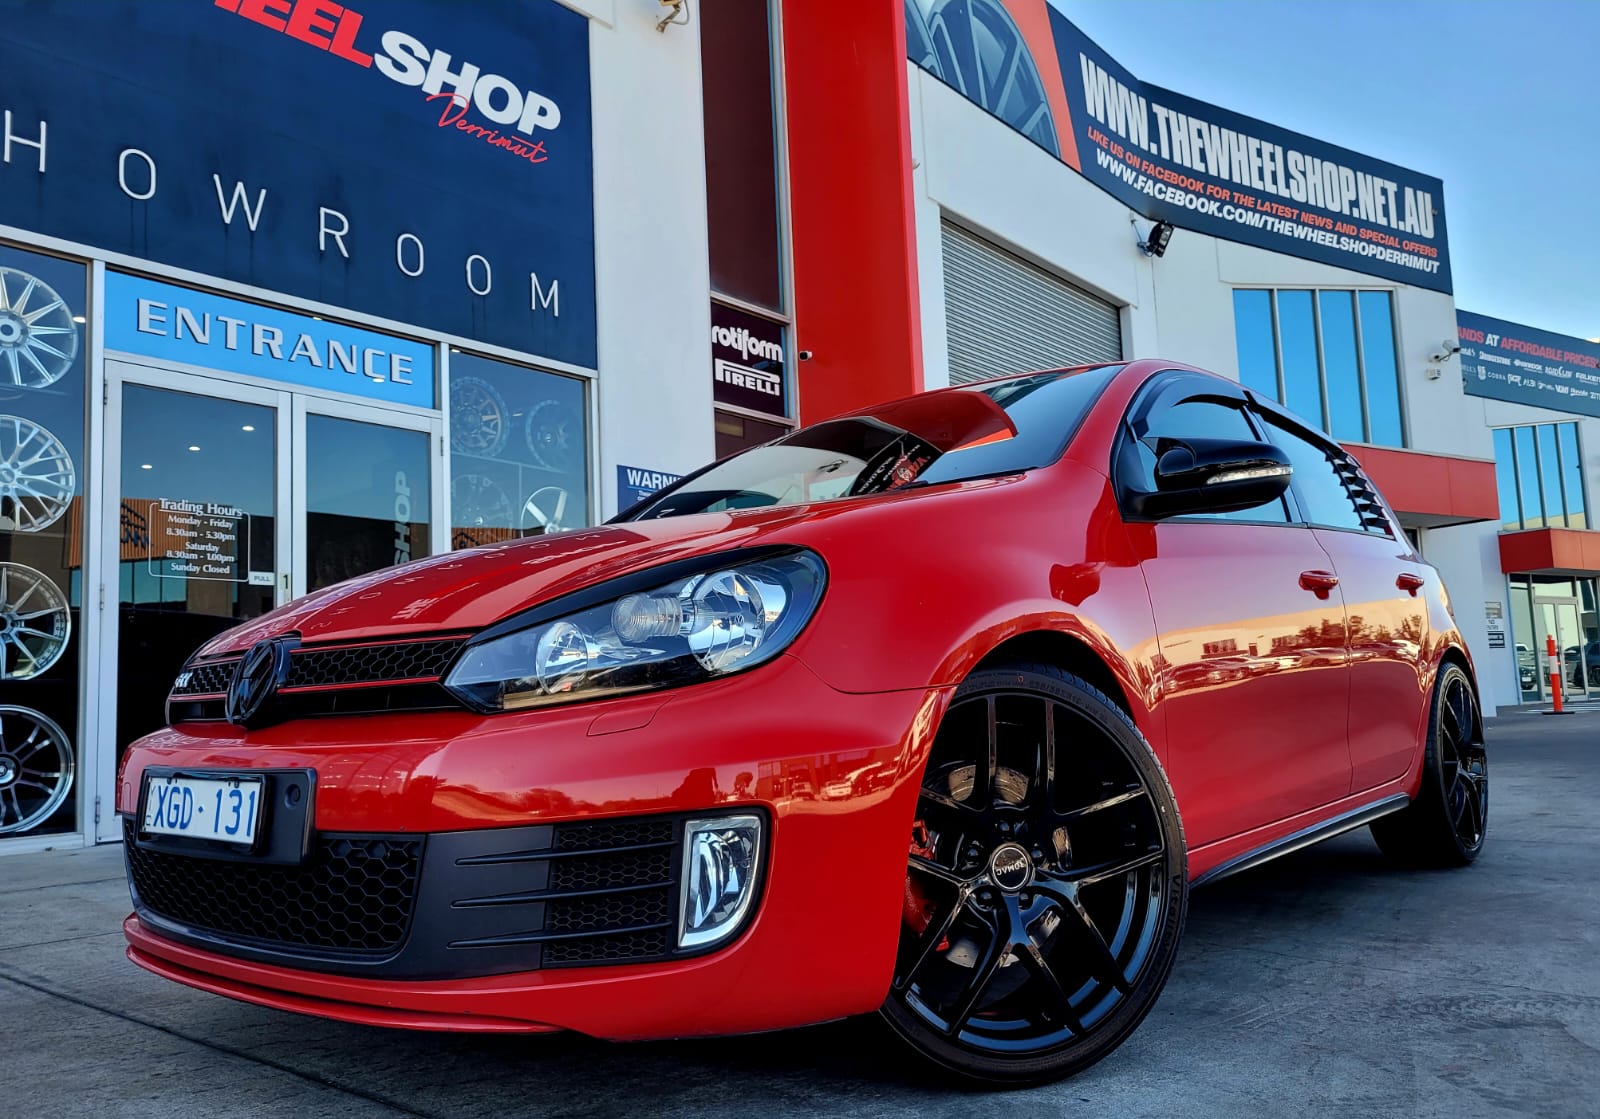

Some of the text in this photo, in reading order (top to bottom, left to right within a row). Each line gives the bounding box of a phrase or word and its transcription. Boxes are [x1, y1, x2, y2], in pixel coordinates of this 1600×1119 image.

[214, 0, 373, 68] EEL
[426, 92, 548, 163] Derrimut
[1079, 52, 1435, 239] WWW.THEWHEELSHOP.NET.AU
[1087, 125, 1438, 257] LIKE US ON FACEBOOK FOR THE LATEST NEWS AND SPECIAL OFFERS
[1096, 147, 1440, 274] WWW.FACEBOOK.COM/THEWHEELSHOPDERRIMUT
[137, 298, 413, 384] ENTRANCE
[711, 325, 784, 363] rotiform
[1485, 332, 1500, 347] AT
[1501, 337, 1562, 361] AFFORDABLE
[714, 358, 780, 396] PIRELLI
[159, 497, 242, 517] Trading Hours
[168, 514, 202, 527] Monday
[209, 519, 233, 530] Friday
[166, 527, 198, 538] 8.30am
[205, 530, 235, 542] 5.30pm
[185, 541, 221, 553] Saturday
[166, 550, 198, 560] 8.30am
[170, 562, 230, 574] Sunday Closed
